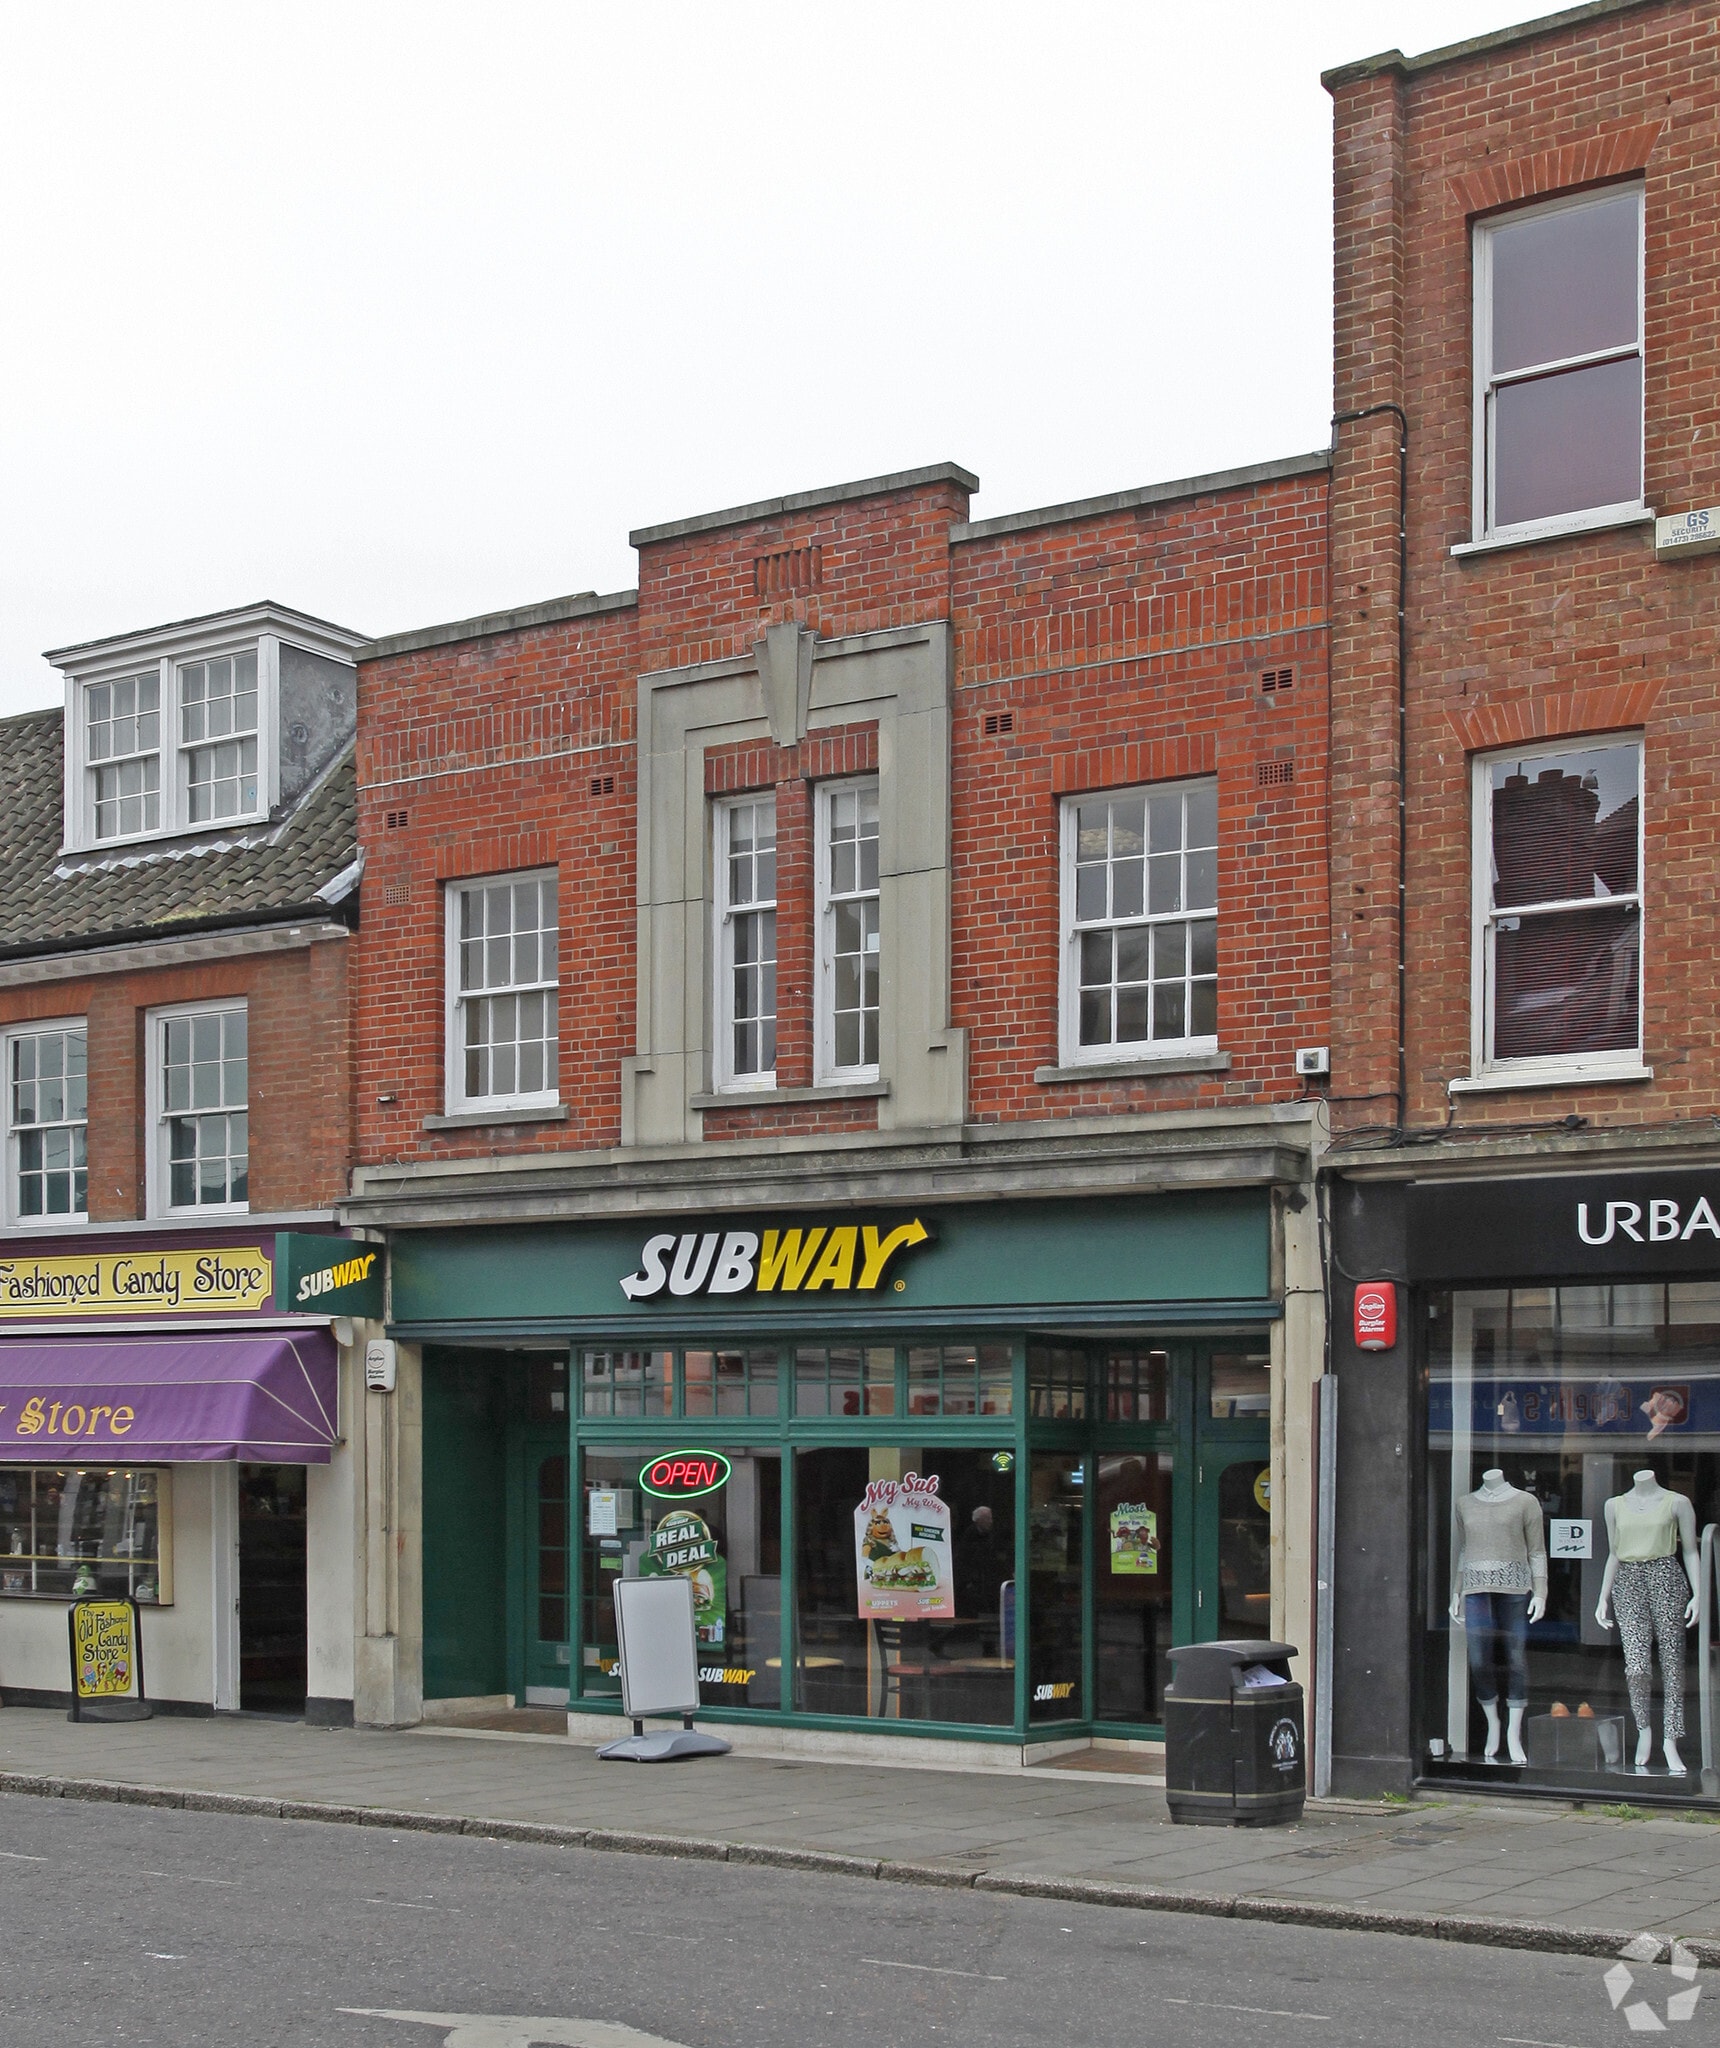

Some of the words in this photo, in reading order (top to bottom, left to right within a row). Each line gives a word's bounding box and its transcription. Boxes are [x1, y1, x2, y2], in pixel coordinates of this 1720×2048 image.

[1672, 525, 1707, 537] SECURITY
[1687, 511, 1709, 527] GS
[1578, 1196, 1720, 1245] URBA
[619, 1217, 929, 1301] SUBWAY
[112, 1258, 181, 1306] Candy
[193, 1256, 263, 1298] Store
[296, 1252, 376, 1302] SUBWAY
[1359, 1319, 1386, 1327] Burglar
[16, 1396, 135, 1435] Store
[650, 1461, 718, 1486] OPEN
[861, 1480, 898, 1511] My
[901, 1473, 938, 1494] Sub
[902, 1497, 919, 1509] My
[922, 1498, 943, 1513] Way
[1114, 1502, 1146, 1517] Most
[656, 1524, 700, 1548] REAL
[666, 1545, 711, 1568] DEAL
[80, 1615, 94, 1642] Old
[98, 1628, 129, 1653] Candy
[83, 1643, 119, 1665] Store
[698, 1667, 756, 1685] SUBWAY
[1033, 1682, 1075, 1701] SUBWAY
